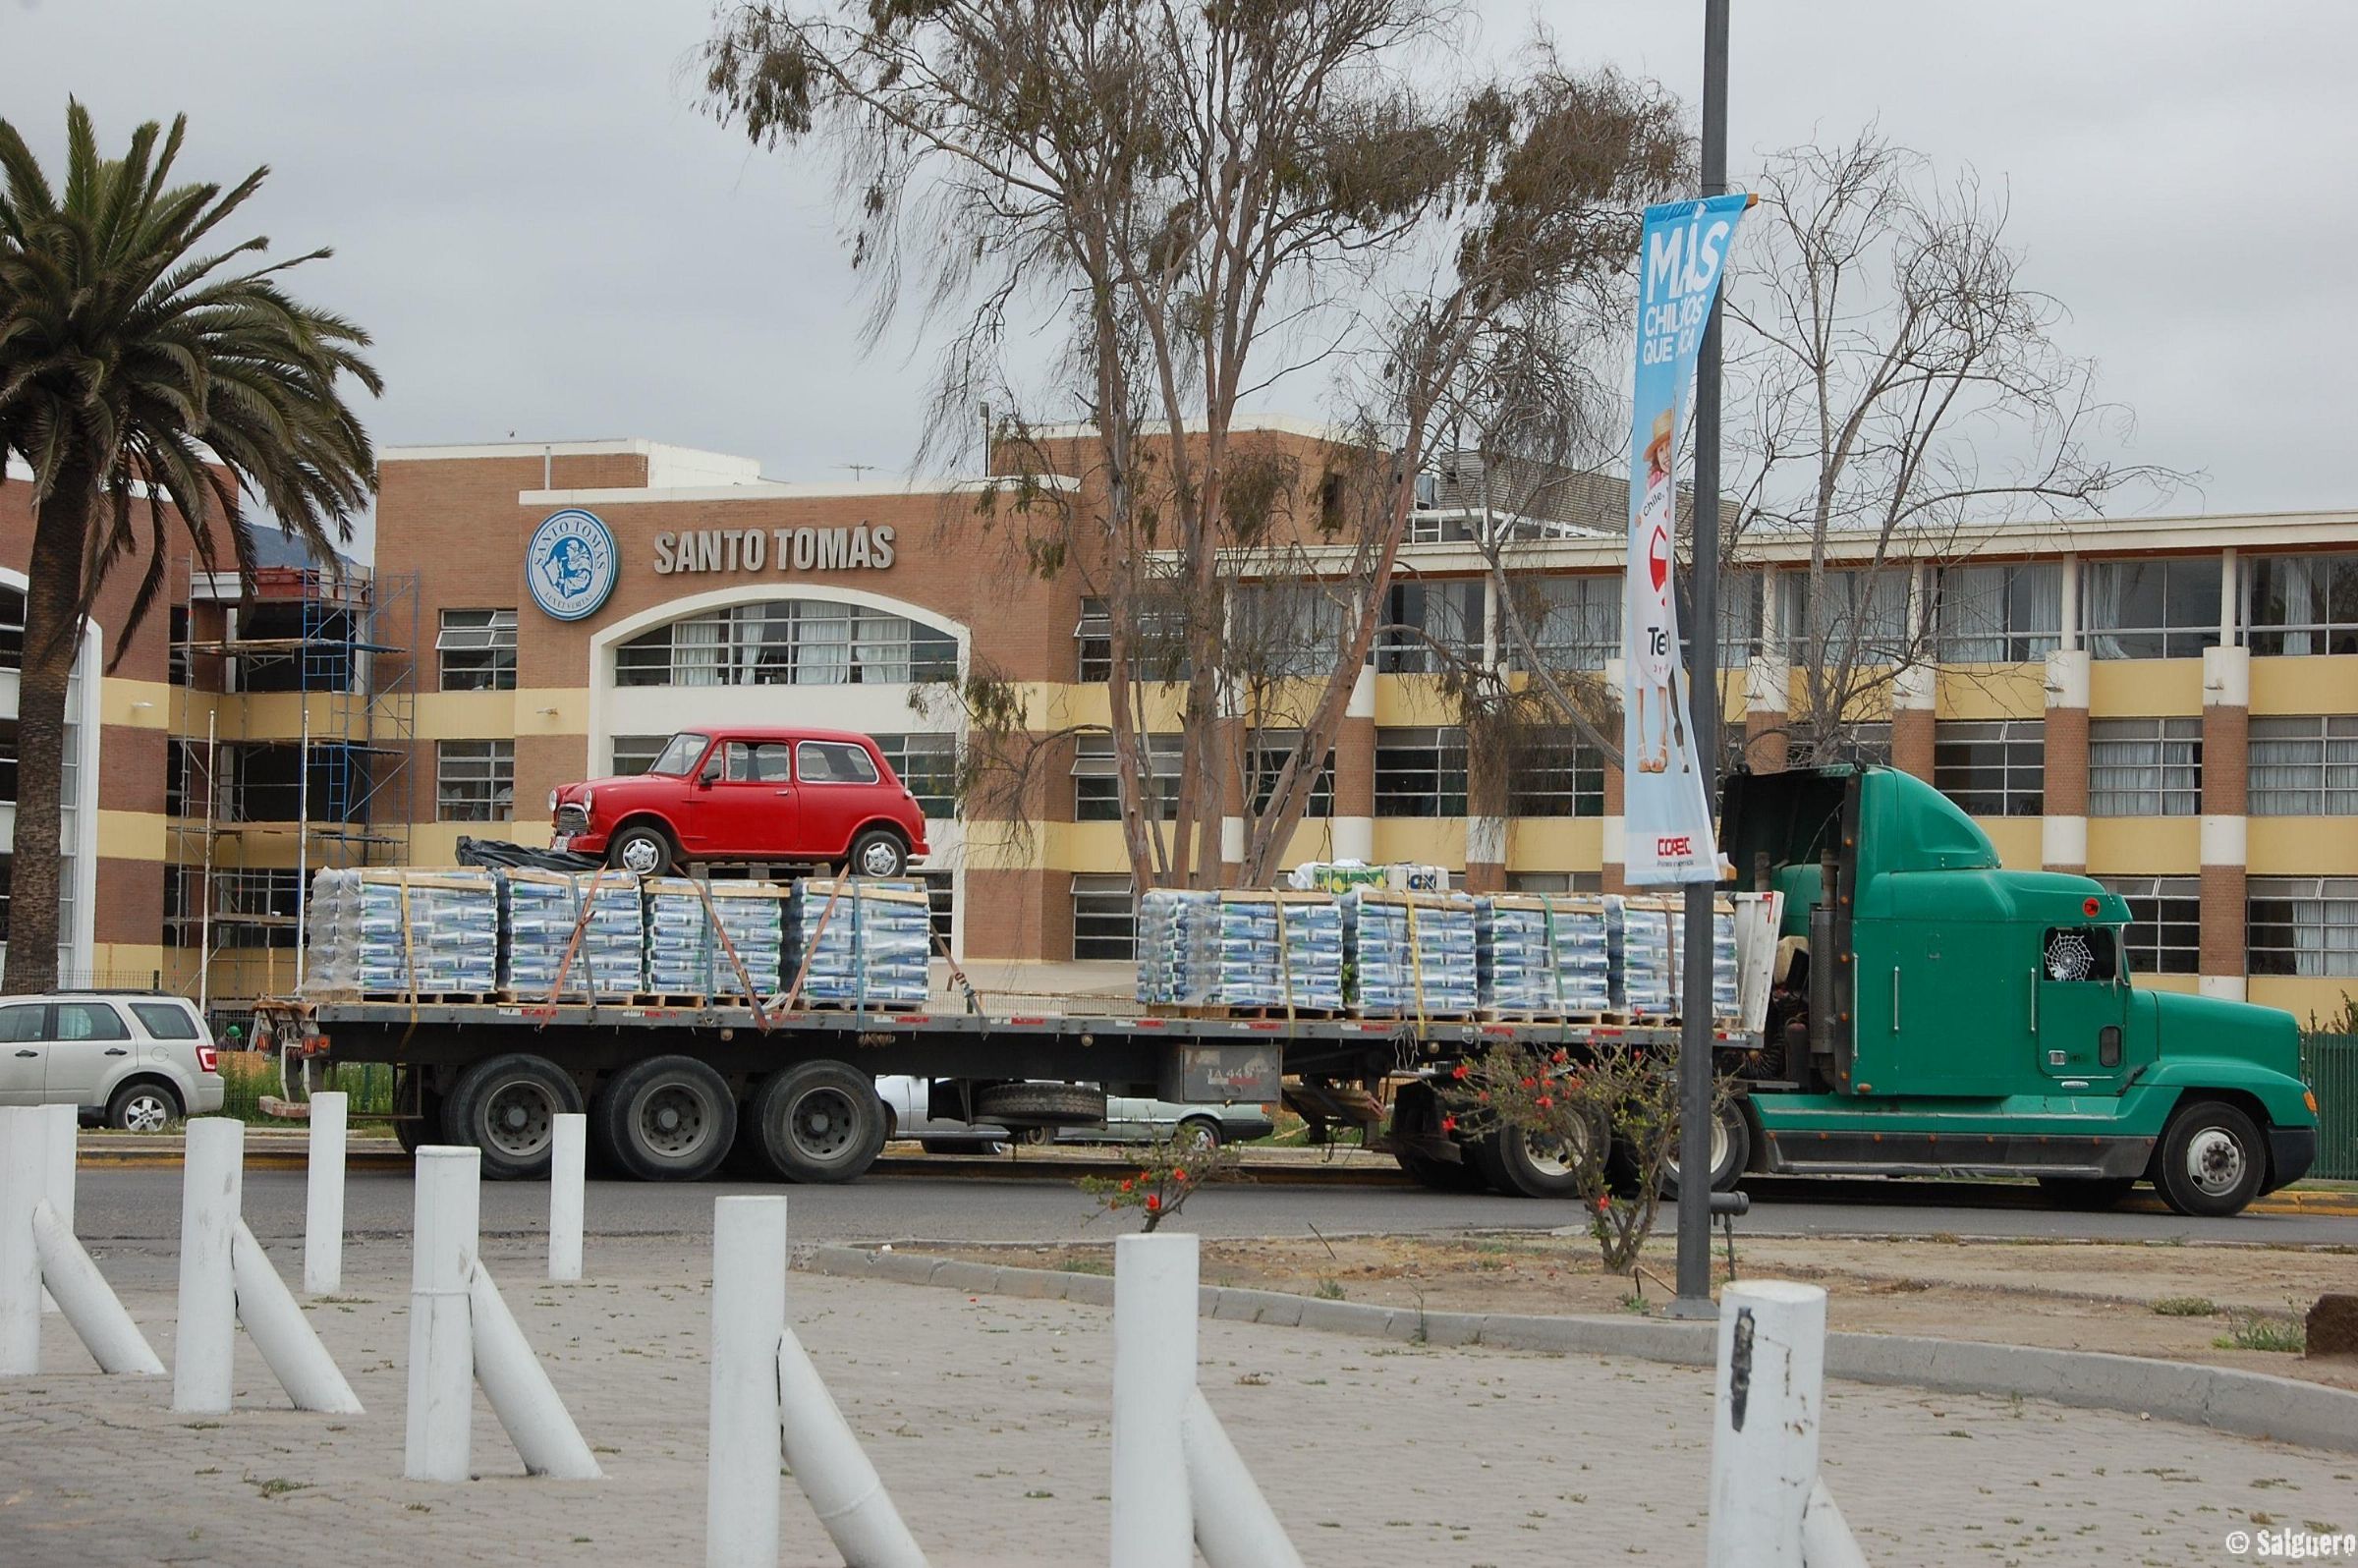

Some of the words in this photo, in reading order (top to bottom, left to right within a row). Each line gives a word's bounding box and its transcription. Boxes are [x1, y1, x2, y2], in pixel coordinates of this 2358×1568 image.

[1647, 201, 1730, 304] MÁS
[1643, 336, 1674, 365] QUE
[534, 522, 569, 566] SANTO
[574, 522, 608, 570] TOMÁS
[653, 528, 767, 575] SANTO
[774, 520, 896, 571] TOMÁS
